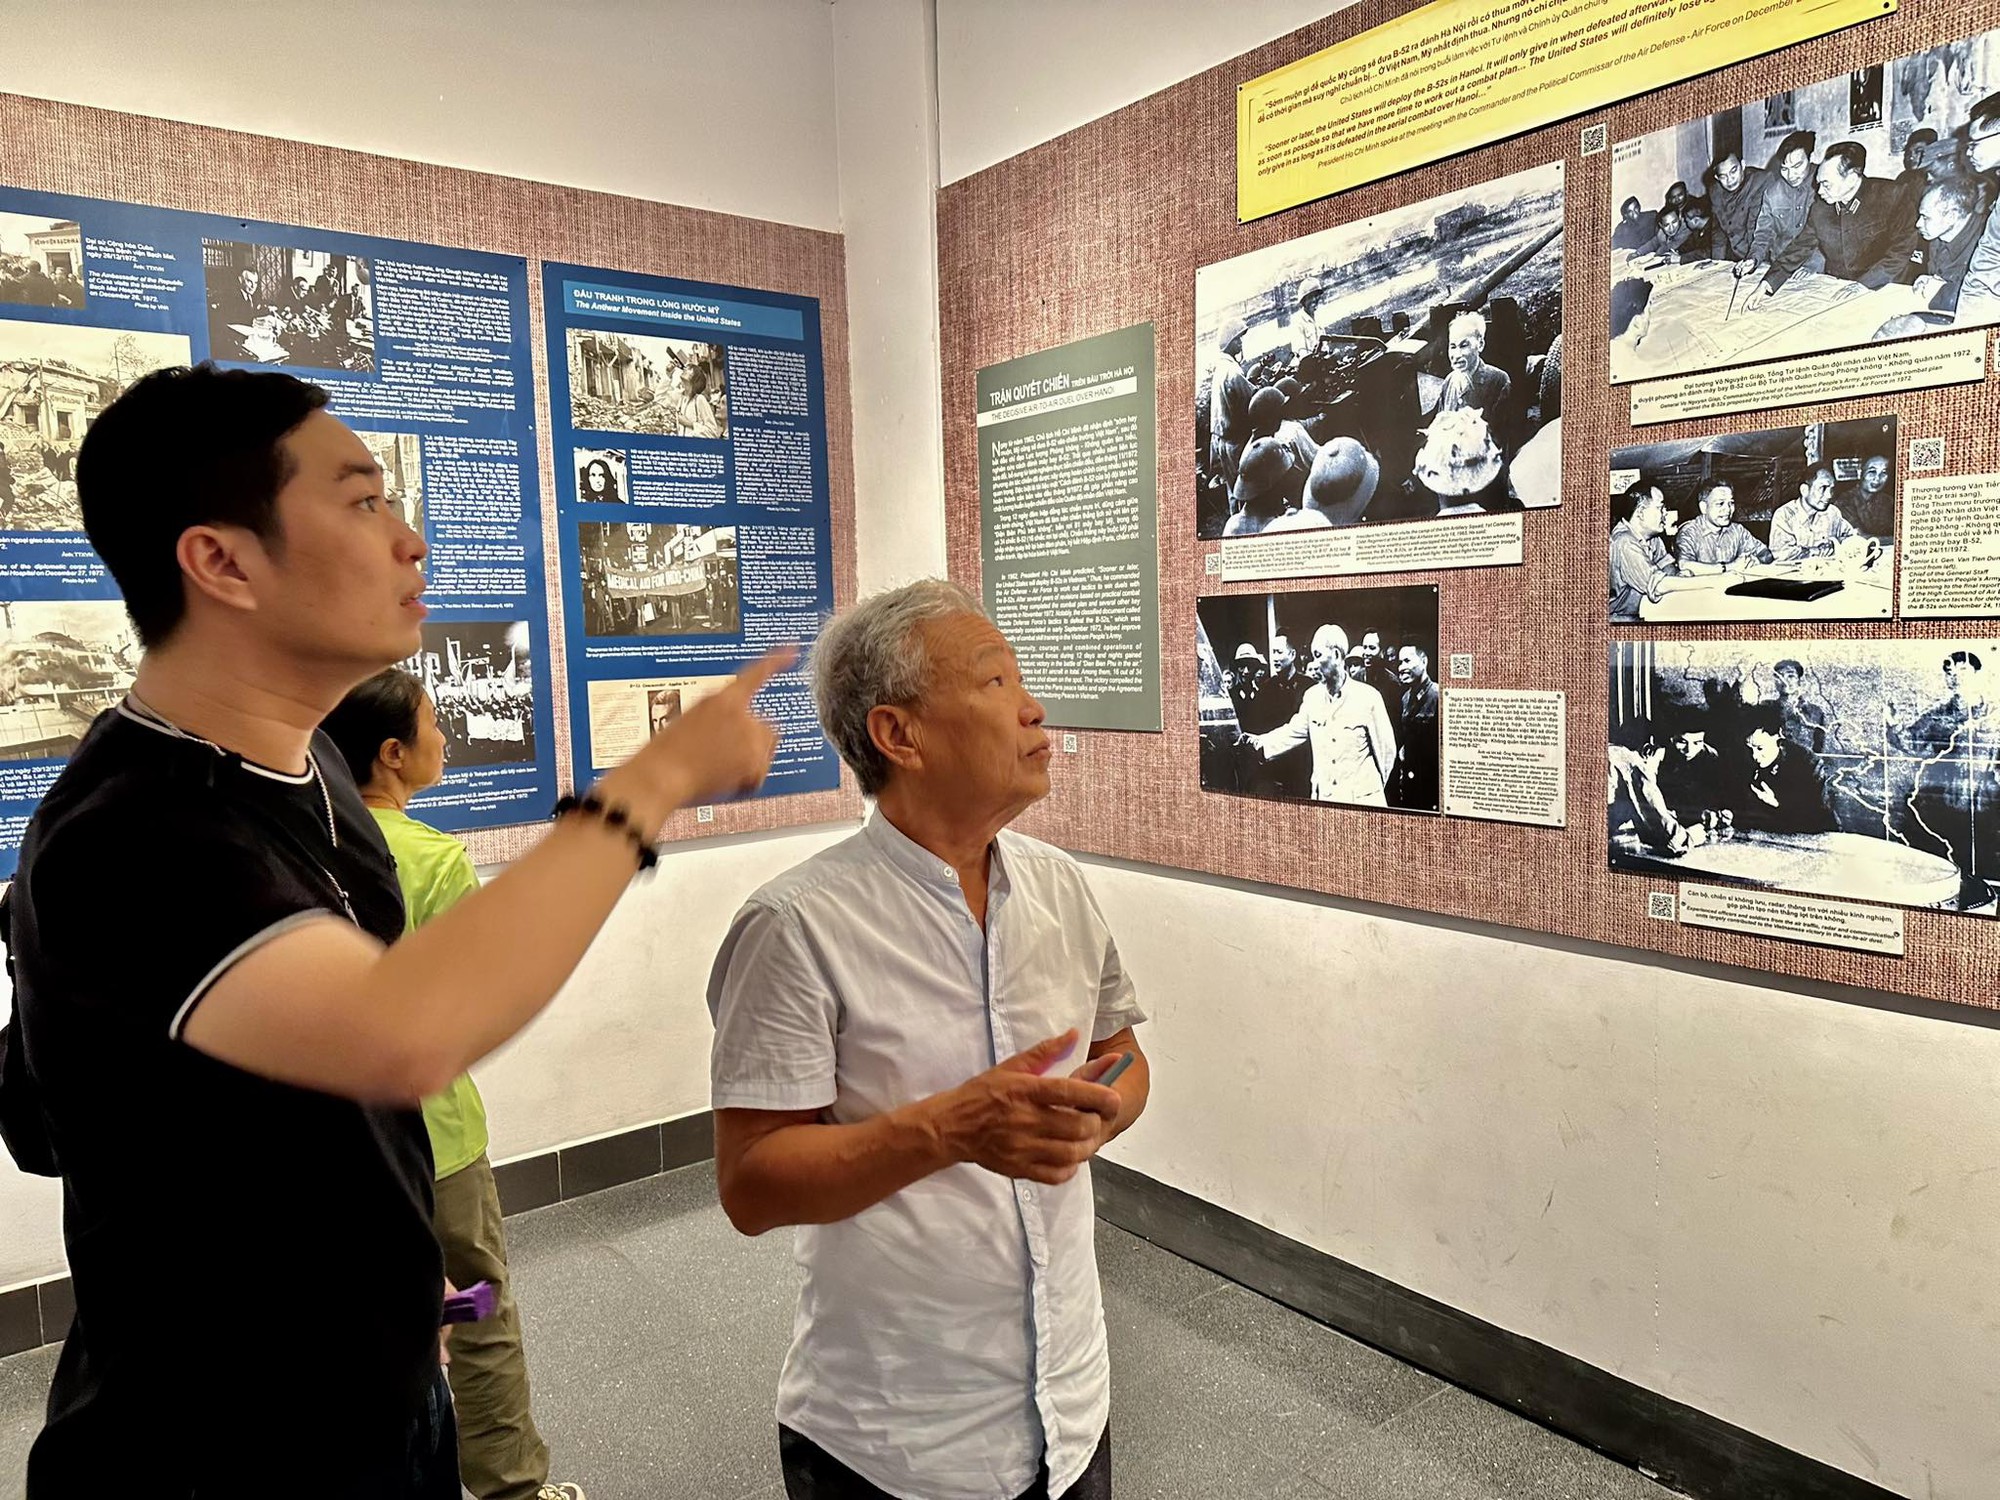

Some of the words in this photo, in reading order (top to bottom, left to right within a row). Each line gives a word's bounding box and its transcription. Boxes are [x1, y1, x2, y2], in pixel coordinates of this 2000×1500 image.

[1284, 90, 1302, 102] muộn
[1320, 75, 1336, 89] quốc
[1338, 70, 1348, 80] Mỹ
[1349, 64, 1366, 76] cũng
[1368, 59, 1376, 69] sẽ
[1377, 54, 1392, 64] đưa
[1393, 44, 1410, 58] B-52
[1411, 43, 1418, 51] ra
[1420, 34, 1439, 47] đánh
[1440, 28, 1451, 39] Hà
[1452, 21, 1466, 34] Nội
[1467, 16, 1478, 28] rồi
[1480, 12, 1490, 23] có
[1492, 5, 1510, 18] thua
[1266, 152, 1282, 163] soon
[1292, 138, 1320, 155] possible
[1321, 134, 1330, 143] so
[1332, 128, 1345, 139] that
[1346, 125, 1356, 133] we
[1357, 118, 1375, 129] have
[1376, 111, 1395, 123] more
[1396, 104, 1413, 115] time
[1414, 100, 1422, 109] to
[1424, 92, 1443, 105] work
[1445, 86, 1458, 97] out
[1466, 71, 1498, 89] combat
[1498, 65, 1526, 80] plan...
[1530, 55, 1545, 66] The
[1548, 41, 1578, 60] United
[1579, 32, 1608, 48] States
[1611, 23, 1628, 37] will
[1630, 7, 1676, 30] definitely
[1679, 0, 1701, 12] lose
[1298, 129, 1315, 140] later,
[1316, 125, 1326, 134] the
[1328, 114, 1350, 129] United
[1350, 107, 1372, 121] States
[1374, 100, 1386, 112] will
[1387, 92, 1412, 107] deploy
[1413, 88, 1426, 98] the
[1426, 79, 1448, 92] B-52s
[1450, 75, 1458, 84] in
[1459, 64, 1485, 80] Hanoi.
[1486, 61, 1492, 70] It
[1494, 54, 1508, 67] will
[1509, 48, 1528, 61] only
[1529, 41, 1548, 56] give
[1549, 37, 1558, 47] in
[1560, 28, 1584, 42] when
[1586, 9, 1628, 33] defeated
[99, 291, 130, 299] December
[573, 289, 593, 299] ĐẤU
[594, 292, 624, 303] TRANH
[625, 296, 656, 306] TRONG
[657, 299, 680, 310] LÒNG
[682, 303, 706, 313] NƯỚC
[708, 306, 720, 314] MỸ
[575, 300, 590, 309] The
[591, 302, 620, 312] Antiwar
[621, 306, 659, 317] Movement
[660, 310, 682, 320] Inside
[696, 314, 719, 324] United
[720, 317, 741, 327] States
[1914, 356, 1933, 364] quân
[990, 388, 1012, 407] TRẬN
[1013, 380, 1042, 400] QUYẾT
[1043, 373, 1070, 393] CHIẾN
[1114, 368, 1123, 378] HÀ
[1123, 366, 1134, 375] NỘI
[991, 412, 1004, 420] THE
[1059, 395, 1074, 406] DUEL
[1076, 390, 1093, 402] OVER
[1094, 386, 1114, 397] HANOI
[607, 574, 639, 590] MEDICAL
[640, 577, 651, 589] AID
[651, 572, 666, 588] FOR
